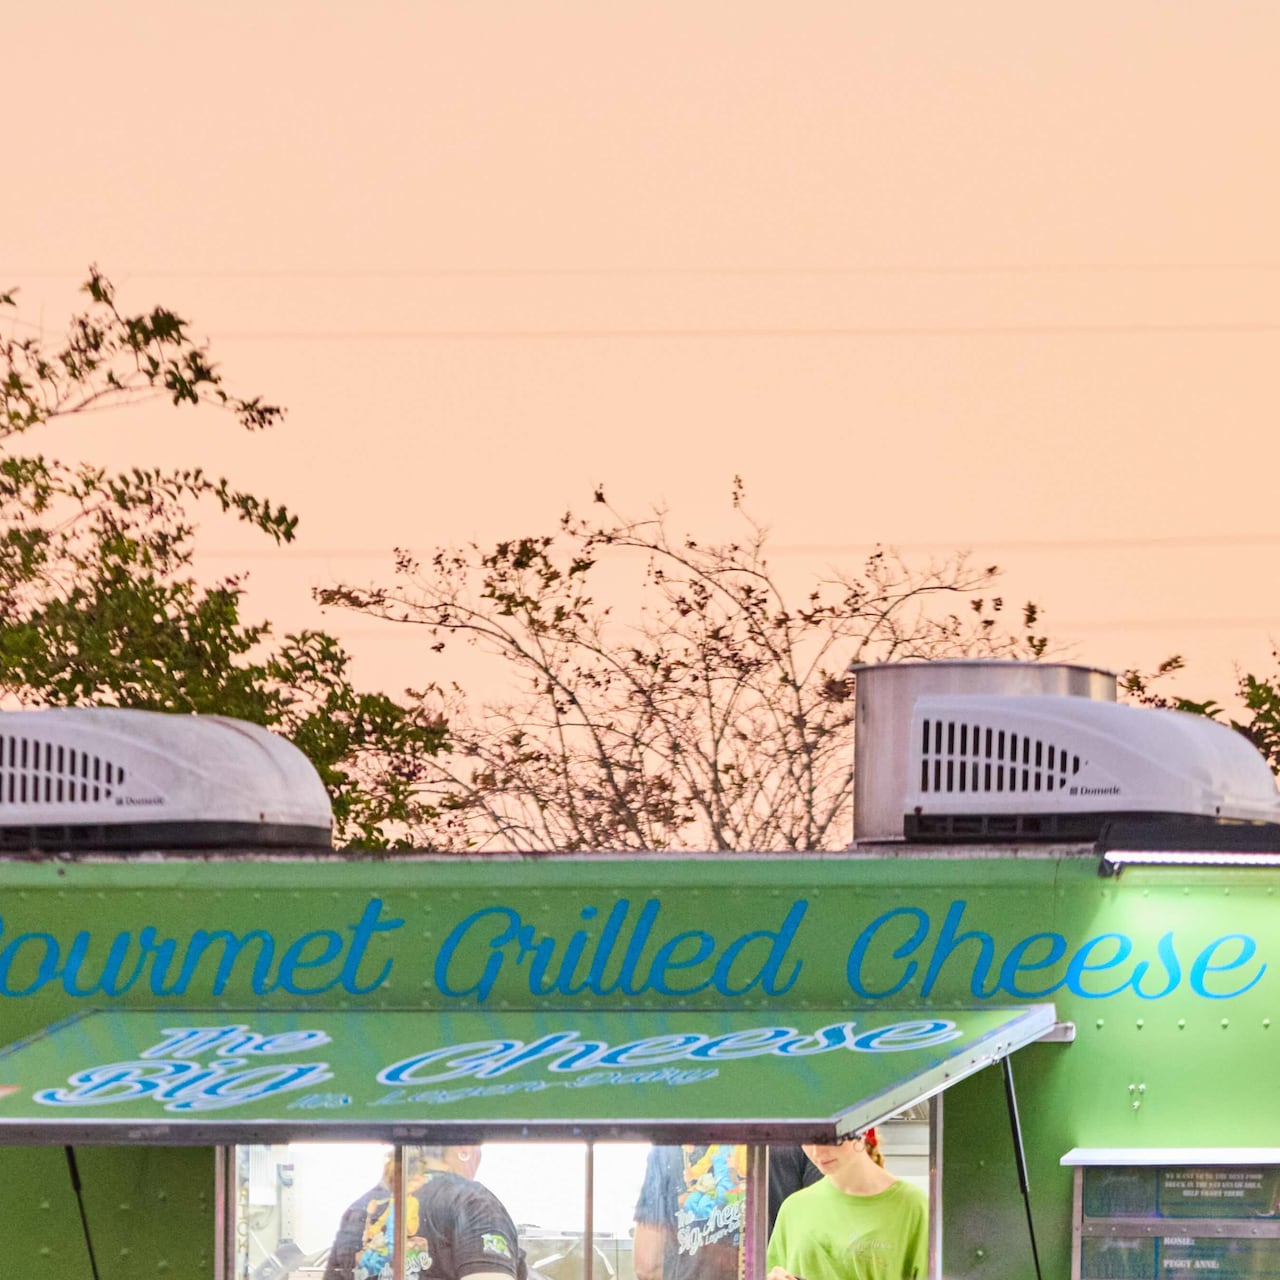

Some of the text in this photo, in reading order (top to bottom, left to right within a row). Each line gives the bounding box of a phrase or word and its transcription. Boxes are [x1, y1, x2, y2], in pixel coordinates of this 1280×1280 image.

[1080, 784, 1121, 796] Dometic
[434, 898, 809, 1004] Grilled
[846, 899, 1268, 999] Cheese
[32, 1019, 964, 1112] Big Cheese
[140, 1024, 334, 1058] The
